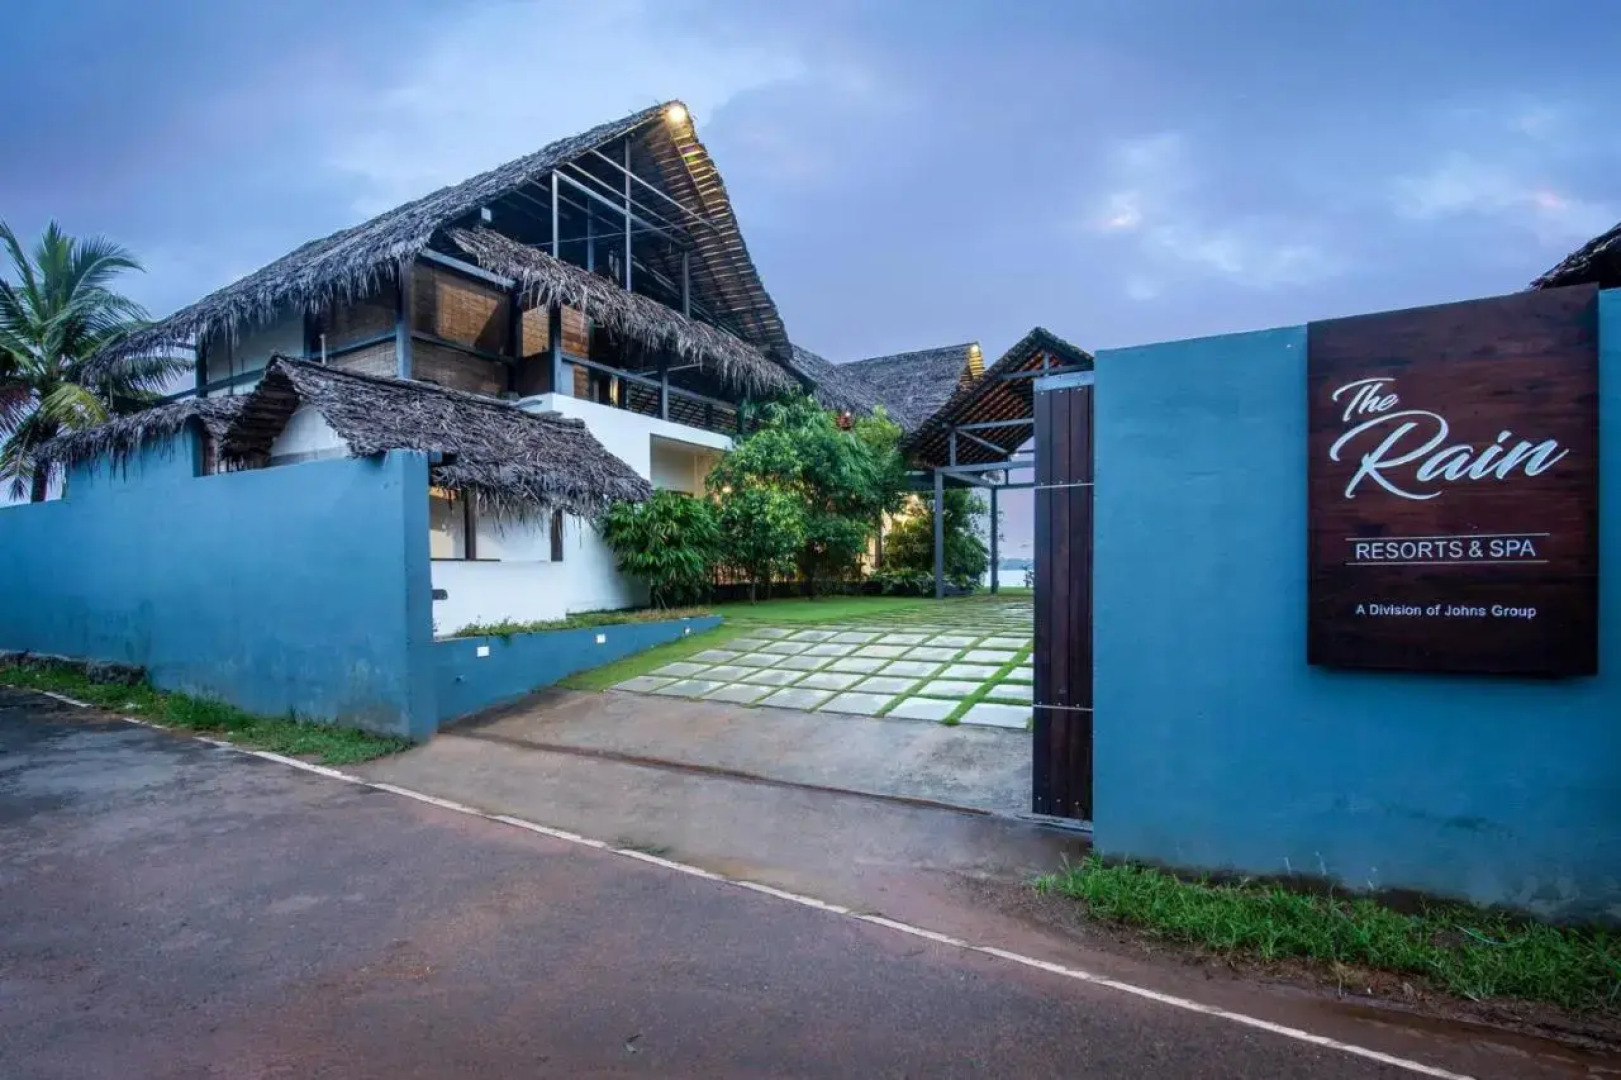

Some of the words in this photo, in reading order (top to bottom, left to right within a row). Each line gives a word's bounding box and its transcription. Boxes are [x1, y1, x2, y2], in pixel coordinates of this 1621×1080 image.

[1332, 377, 1399, 422] The
[1329, 409, 1570, 500] Rain
[1355, 541, 1464, 560] RESORTS
[1468, 540, 1484, 558] &
[1489, 539, 1536, 558] SPA
[1355, 604, 1366, 616] A
[1369, 604, 1422, 616] Division
[1426, 604, 1441, 616] of
[1444, 605, 1487, 617] Johns
[1491, 605, 1537, 620] Group
